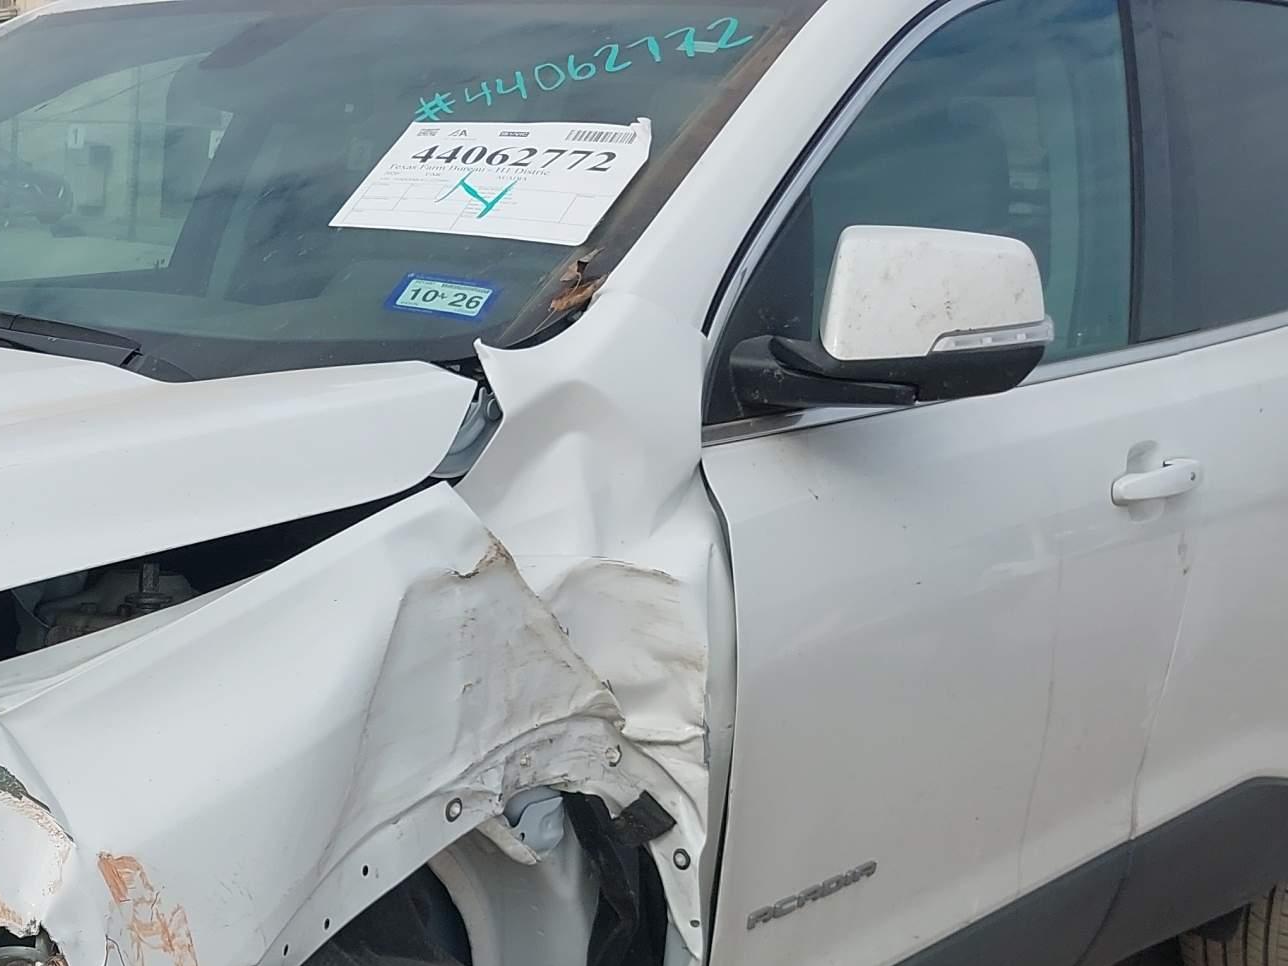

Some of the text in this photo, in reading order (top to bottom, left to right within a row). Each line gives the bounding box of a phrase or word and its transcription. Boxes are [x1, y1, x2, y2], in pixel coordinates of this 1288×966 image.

[411, 144, 617, 172] 44062772
[411, 287, 440, 303] 10
[448, 292, 484, 310] 26
